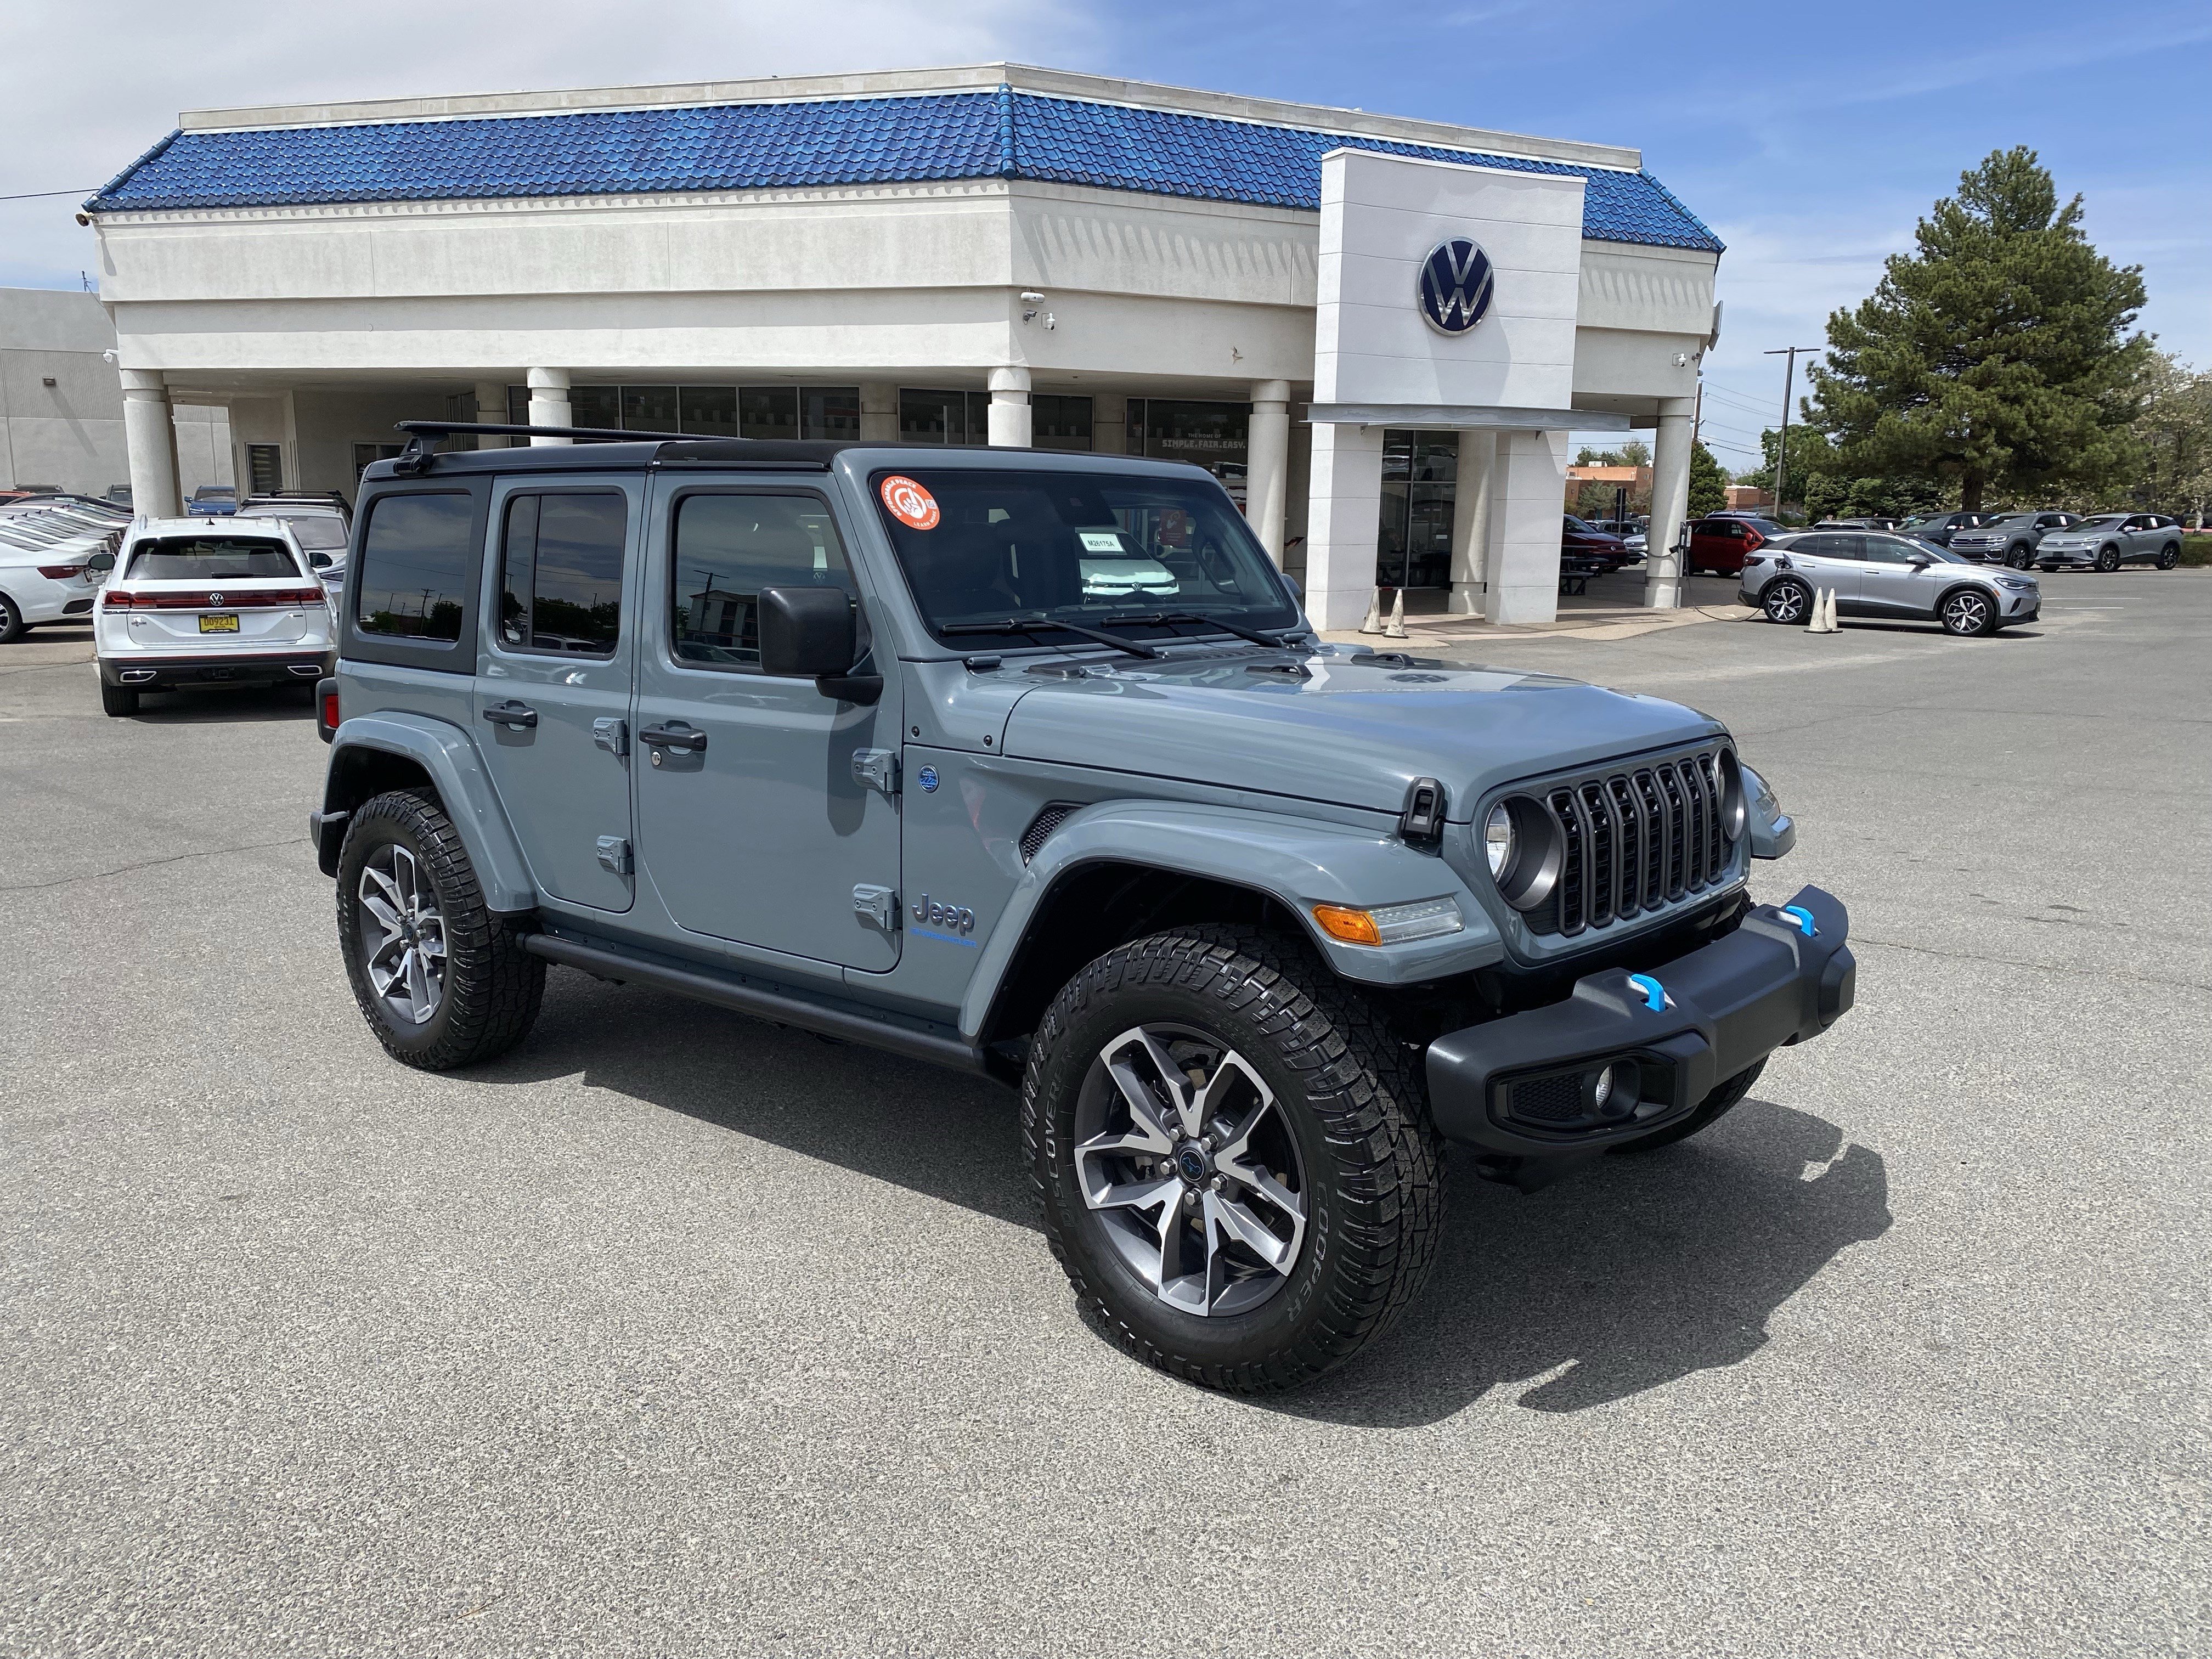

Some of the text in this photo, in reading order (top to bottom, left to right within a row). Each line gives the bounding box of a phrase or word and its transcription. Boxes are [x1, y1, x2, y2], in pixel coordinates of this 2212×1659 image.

[895, 479, 917, 489] PEACE
[912, 893, 975, 936] Jeep
[1045, 1045, 1075, 1228] DISCOVERER
[1286, 1181, 1329, 1322] COOPER
